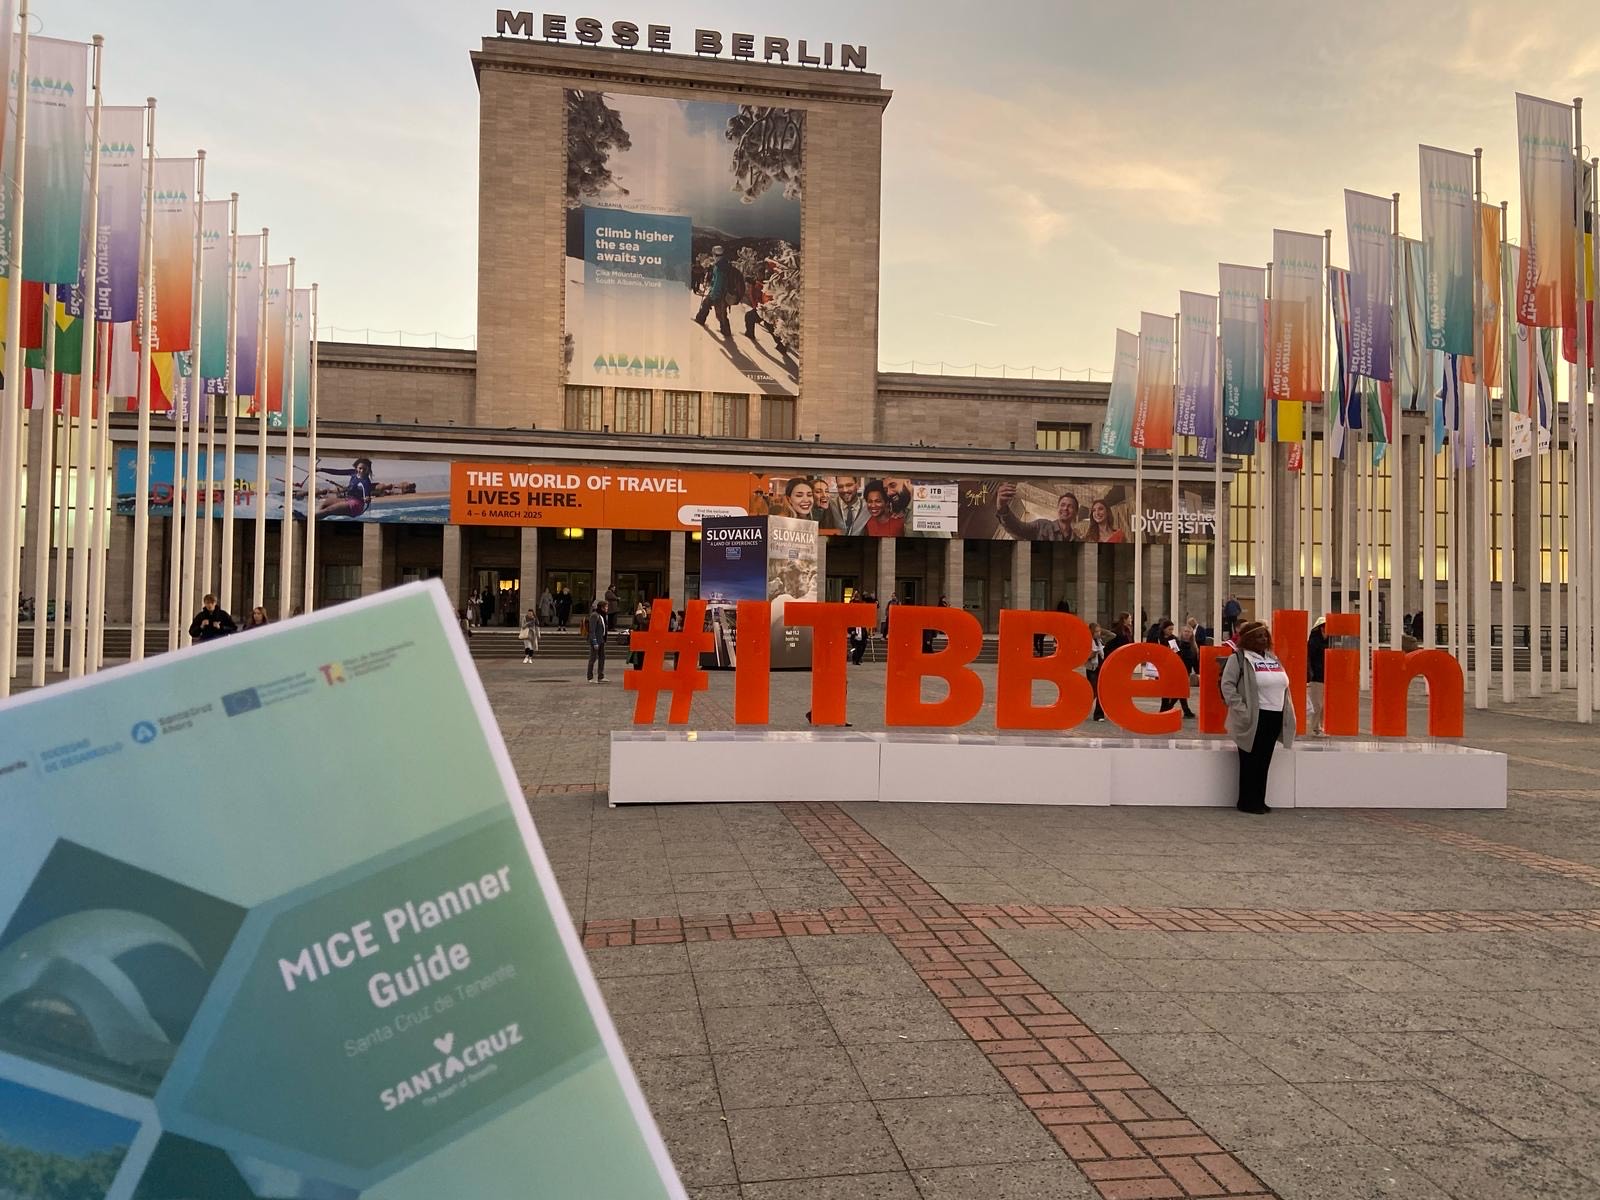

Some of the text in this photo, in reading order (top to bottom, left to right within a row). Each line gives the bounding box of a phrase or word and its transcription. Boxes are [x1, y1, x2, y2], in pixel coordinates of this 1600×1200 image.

[496, 9, 868, 71] MESSE BERLIN
[595, 227, 674, 242] Climb higher
[595, 239, 640, 252] the sea
[596, 252, 662, 266] awaits you
[593, 354, 680, 370] ALBANIA
[466, 471, 688, 493] THE WORLD OF TRAVEL
[466, 490, 582, 508] LIVES HERE.
[466, 510, 472, 518] 4
[481, 510, 487, 518] 6
[489, 510, 521, 519] MARCH
[523, 511, 543, 520] 2025
[706, 528, 762, 541] SLOVAKIA
[773, 529, 815, 544] SLOVAKIA
[278, 865, 511, 992] MICE Planner
[368, 943, 472, 1008] Guide
[344, 1023, 394, 1058] Santa
[394, 1005, 433, 1032] Cruz
[433, 990, 455, 1014] de
